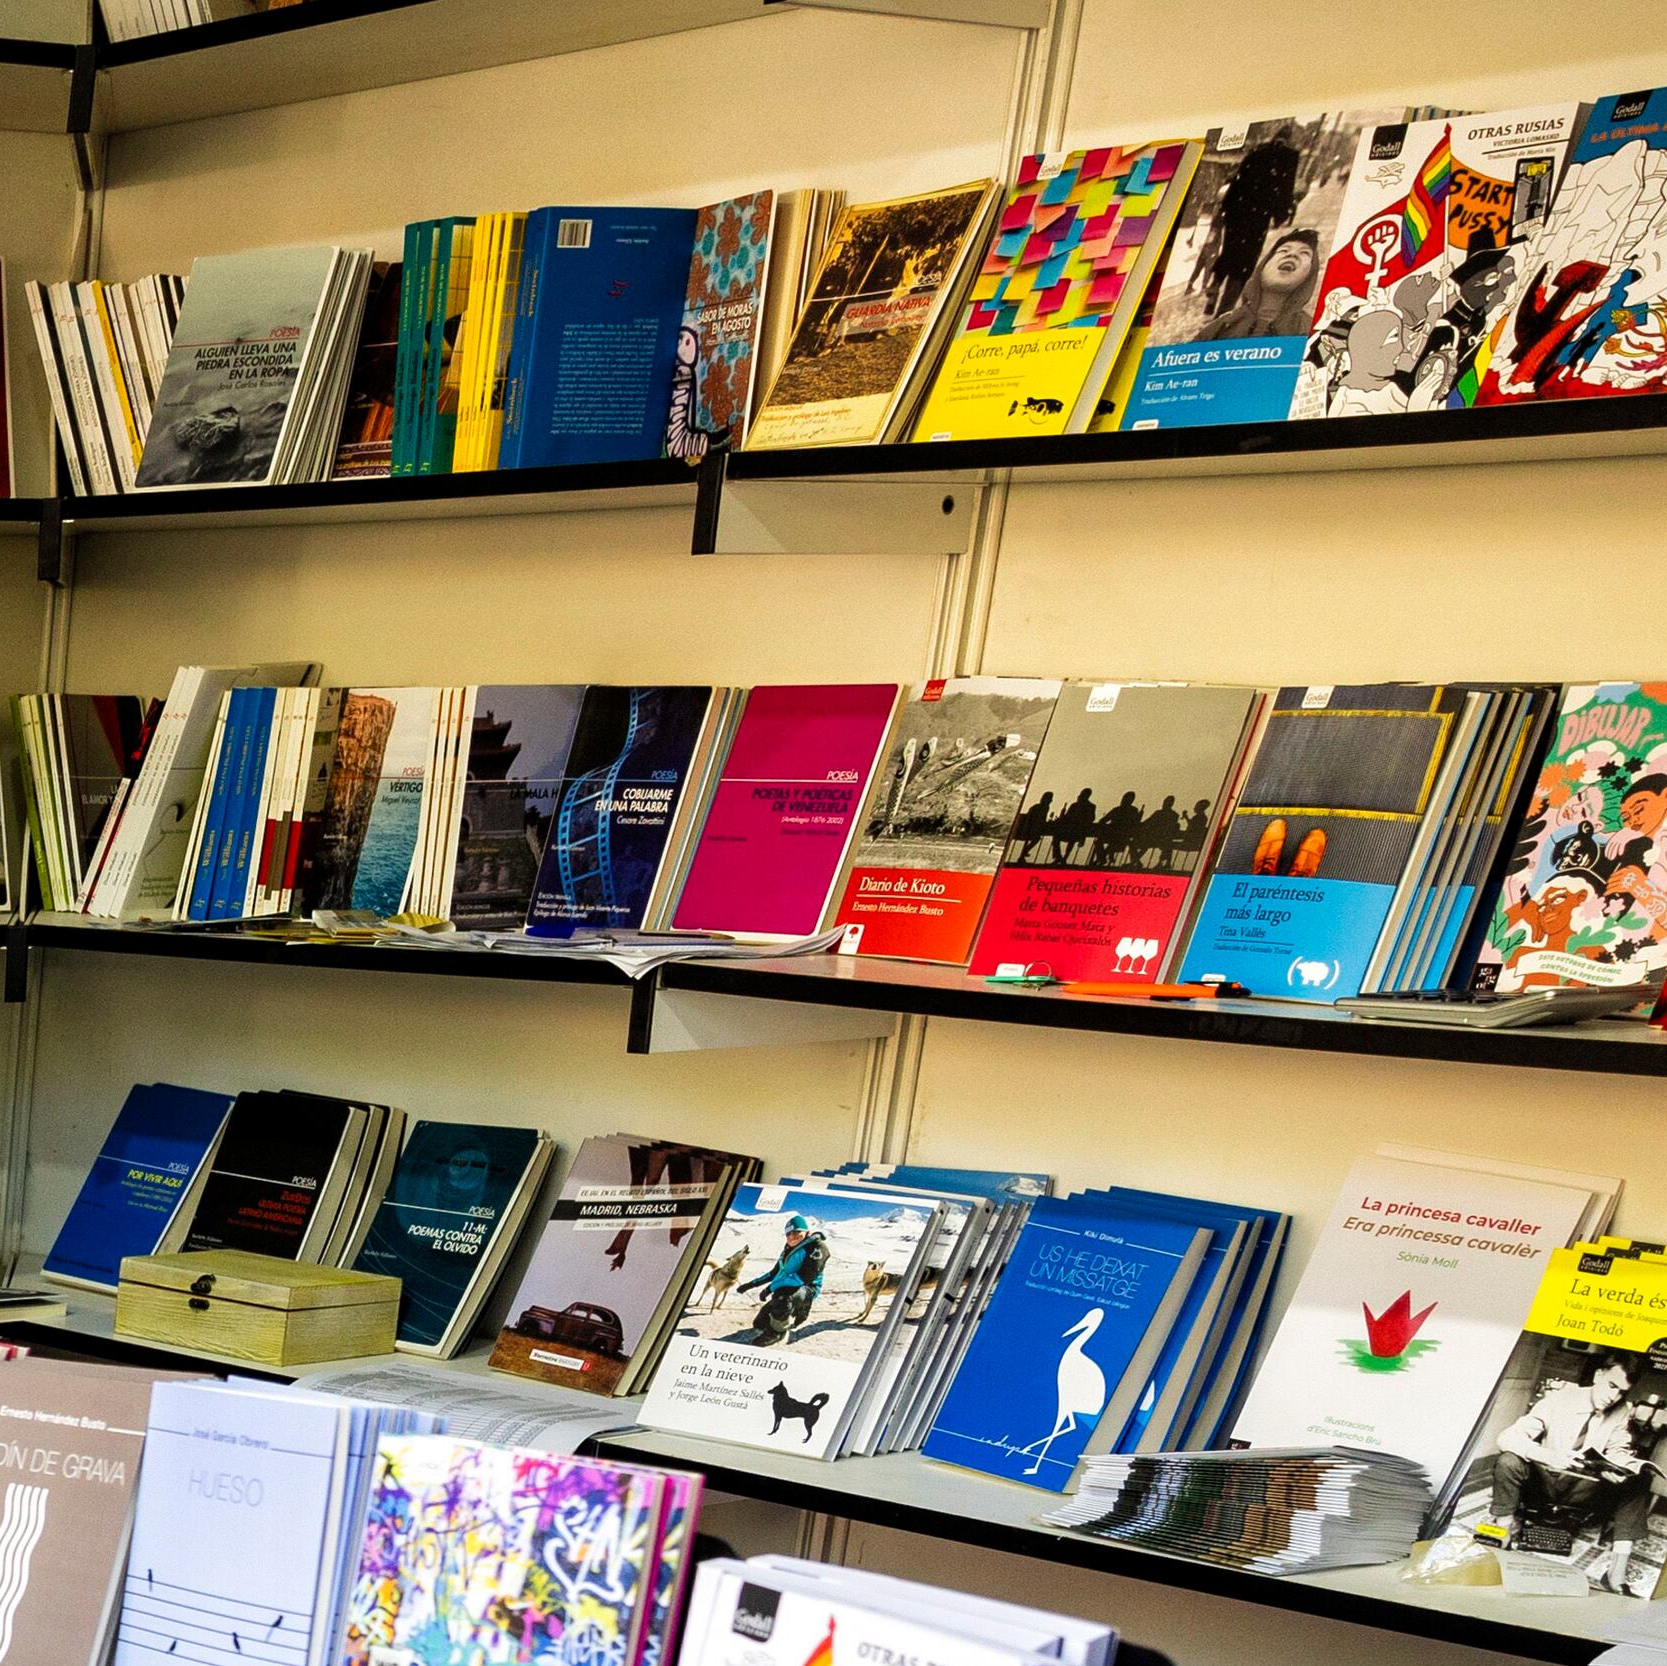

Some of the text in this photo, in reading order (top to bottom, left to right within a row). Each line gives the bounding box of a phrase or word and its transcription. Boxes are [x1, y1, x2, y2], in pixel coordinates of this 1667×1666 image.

[1467, 118, 1565, 140] OTRAS RUSIAS
[1448, 169, 1517, 207] START
[962, 336, 1087, 364] ¡Corre, papá, corre!
[1152, 345, 1282, 368] Afuera es verano
[1557, 703, 1652, 755] DIBUJAR
[826, 770, 859, 781] POESÍA
[859, 876, 946, 896] Diario de Kioto
[1233, 882, 1325, 903] El paréntesis
[1224, 904, 1291, 926] más largo
[580, 1203, 677, 1217] MADRID, NEBRASKA
[1361, 1196, 1542, 1237] La princesa cavaller
[408, 1225, 482, 1244] POEMAS CONTRA
[1342, 1216, 1542, 1260] Era princessa cavalèr
[433, 1240, 478, 1255] EL OLVIDO
[1039, 1242, 1064, 1262] US
[1065, 1248, 1091, 1268] HE
[1029, 1260, 1056, 1280] UN
[1396, 1250, 1459, 1269] Sònia Moll
[1569, 1278, 1644, 1306] La verda
[1555, 1314, 1624, 1337] Joan Todó
[689, 1344, 789, 1371] Un veterinario
[681, 1363, 754, 1384] en la nieve
[29, 1448, 59, 1475] DE
[61, 1452, 126, 1487] GRAVA
[187, 1466, 265, 1508] HUESO
